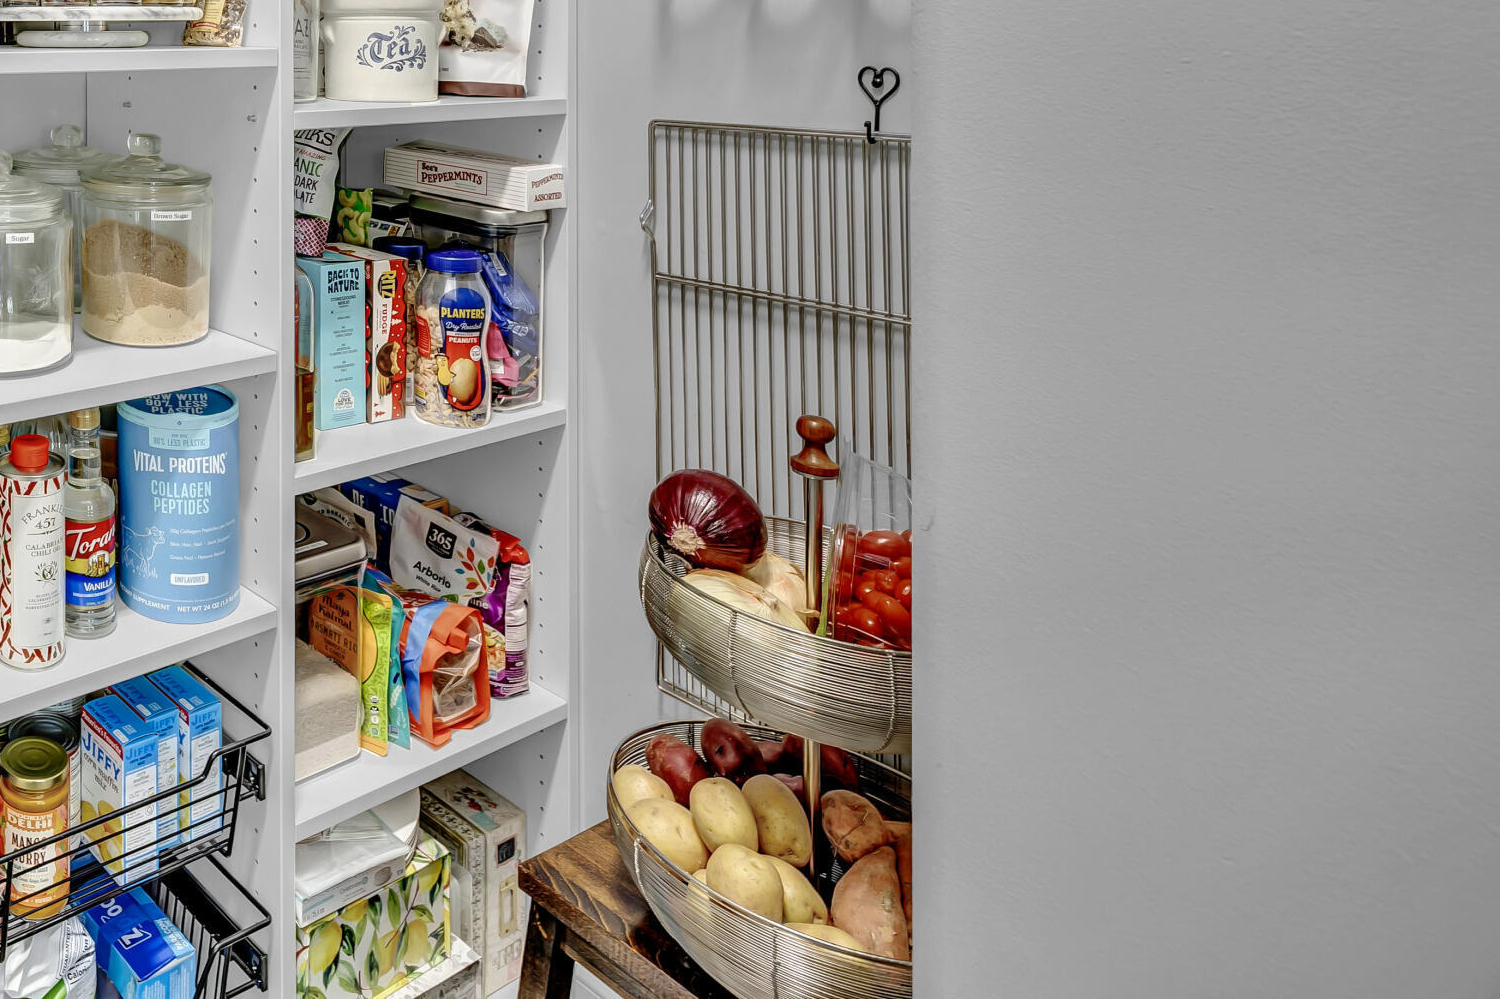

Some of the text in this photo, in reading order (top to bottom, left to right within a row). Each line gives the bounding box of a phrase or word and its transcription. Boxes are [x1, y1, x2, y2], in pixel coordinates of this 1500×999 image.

[367, 32, 411, 63] Tea
[421, 162, 438, 172] See's
[420, 171, 484, 186] PEPPERMINTS
[532, 191, 563, 203] ASSORTED
[11, 234, 30, 242] Sugar
[327, 267, 360, 281] BACK TO
[327, 279, 360, 294] NATURE
[380, 270, 397, 299] RITZ
[441, 307, 486, 320] PLANTERS
[446, 322, 460, 331] Dry
[448, 336, 478, 344] PEANUTS
[145, 399, 208, 408] 90% LESS
[151, 406, 204, 414] PLASTIC
[167, 438, 181, 447] LESS
[182, 438, 206, 447] PLASTIC
[133, 448, 226, 475] VITAL PROTEINS
[151, 479, 212, 499] COLLAGEN
[153, 497, 210, 516] PEPTIDES
[35, 517, 57, 530] 457
[428, 528, 453, 550] 365
[31, 549, 52, 558] CHILI
[174, 575, 206, 584] UNFLAVORED
[412, 560, 451, 589] Arborio
[84, 577, 114, 592] VANILLA
[416, 574, 442, 593] White Rice
[132, 595, 171, 611] SUPPLEMENT
[211, 602, 220, 610] OZ
[322, 596, 350, 617] Maya
[191, 709, 219, 726] JIFFY
[82, 732, 121, 782] JIFFY
[125, 741, 156, 761] JIFFY
[7, 813, 53, 829] DELHI
